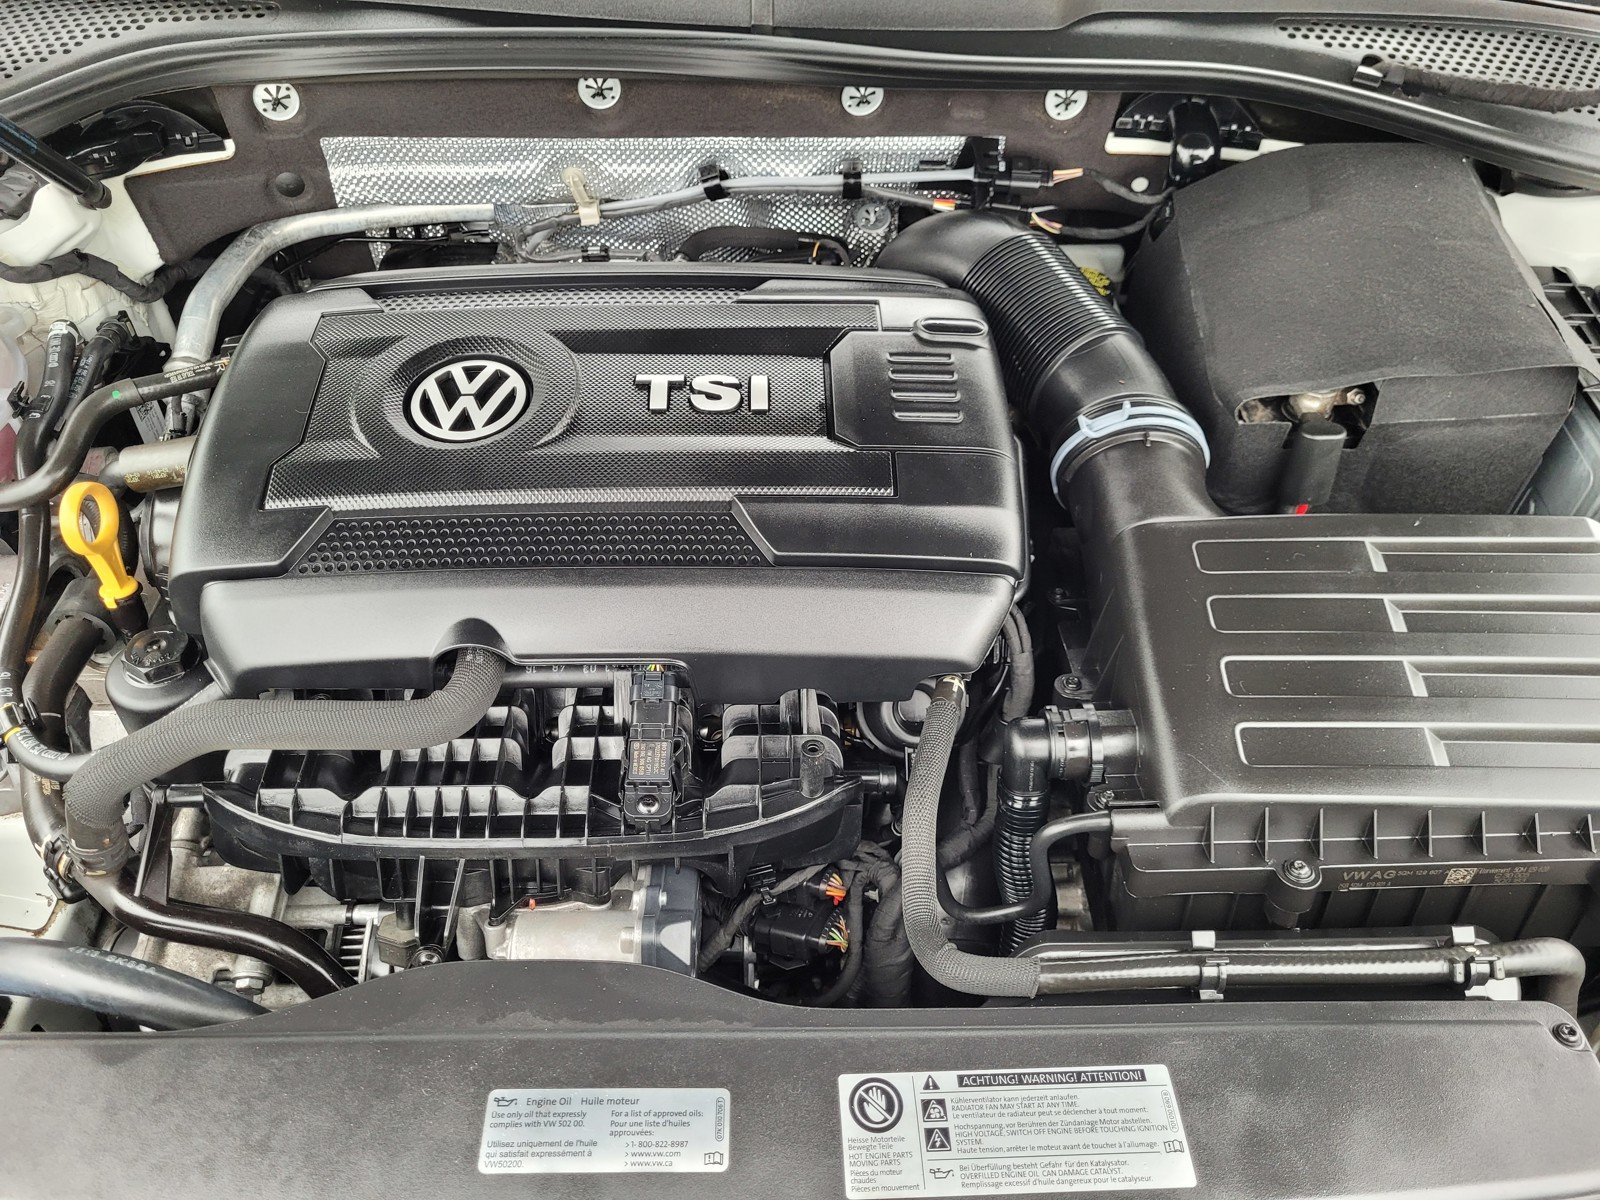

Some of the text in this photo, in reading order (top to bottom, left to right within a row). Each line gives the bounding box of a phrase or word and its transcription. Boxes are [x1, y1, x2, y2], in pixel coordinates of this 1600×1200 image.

[634, 374, 769, 413] TSI
[410, 359, 527, 441] VW
[1342, 871, 1370, 880] VW
[1370, 870, 1397, 880] AG
[962, 1071, 1142, 1086] ACHTUNG! WARNING! ATTENTION!
[527, 1098, 556, 1108] Engine
[559, 1097, 572, 1106] Oil
[581, 1097, 604, 1105] Huile
[951, 1096, 1002, 1104] Kühlerventilator
[506, 1111, 522, 1120] only
[524, 1110, 534, 1118] oil
[552, 1110, 587, 1119] expressly
[652, 1110, 687, 1118] approved
[1038, 1110, 1053, 1118] peut
[1063, 1108, 1097, 1116] déclencher
[490, 1121, 522, 1129] complies
[1060, 1120, 1098, 1128] Zündanlage
[609, 1129, 654, 1138] approuvées:
[486, 1140, 514, 1148] Utilisez
[848, 1144, 877, 1152] Bewegte
[531, 1150, 586, 1158] expressément
[971, 1163, 1011, 1171] Überfüllung
[1090, 1160, 1129, 1168] Katalysator.
[960, 1172, 1000, 1180] OVERFILLED
[1001, 1171, 1026, 1179] ENGINE
[961, 1181, 1003, 1189] Remplissage
[1057, 1178, 1092, 1186] dangereux
[1118, 1176, 1153, 1184] catalyseur.
